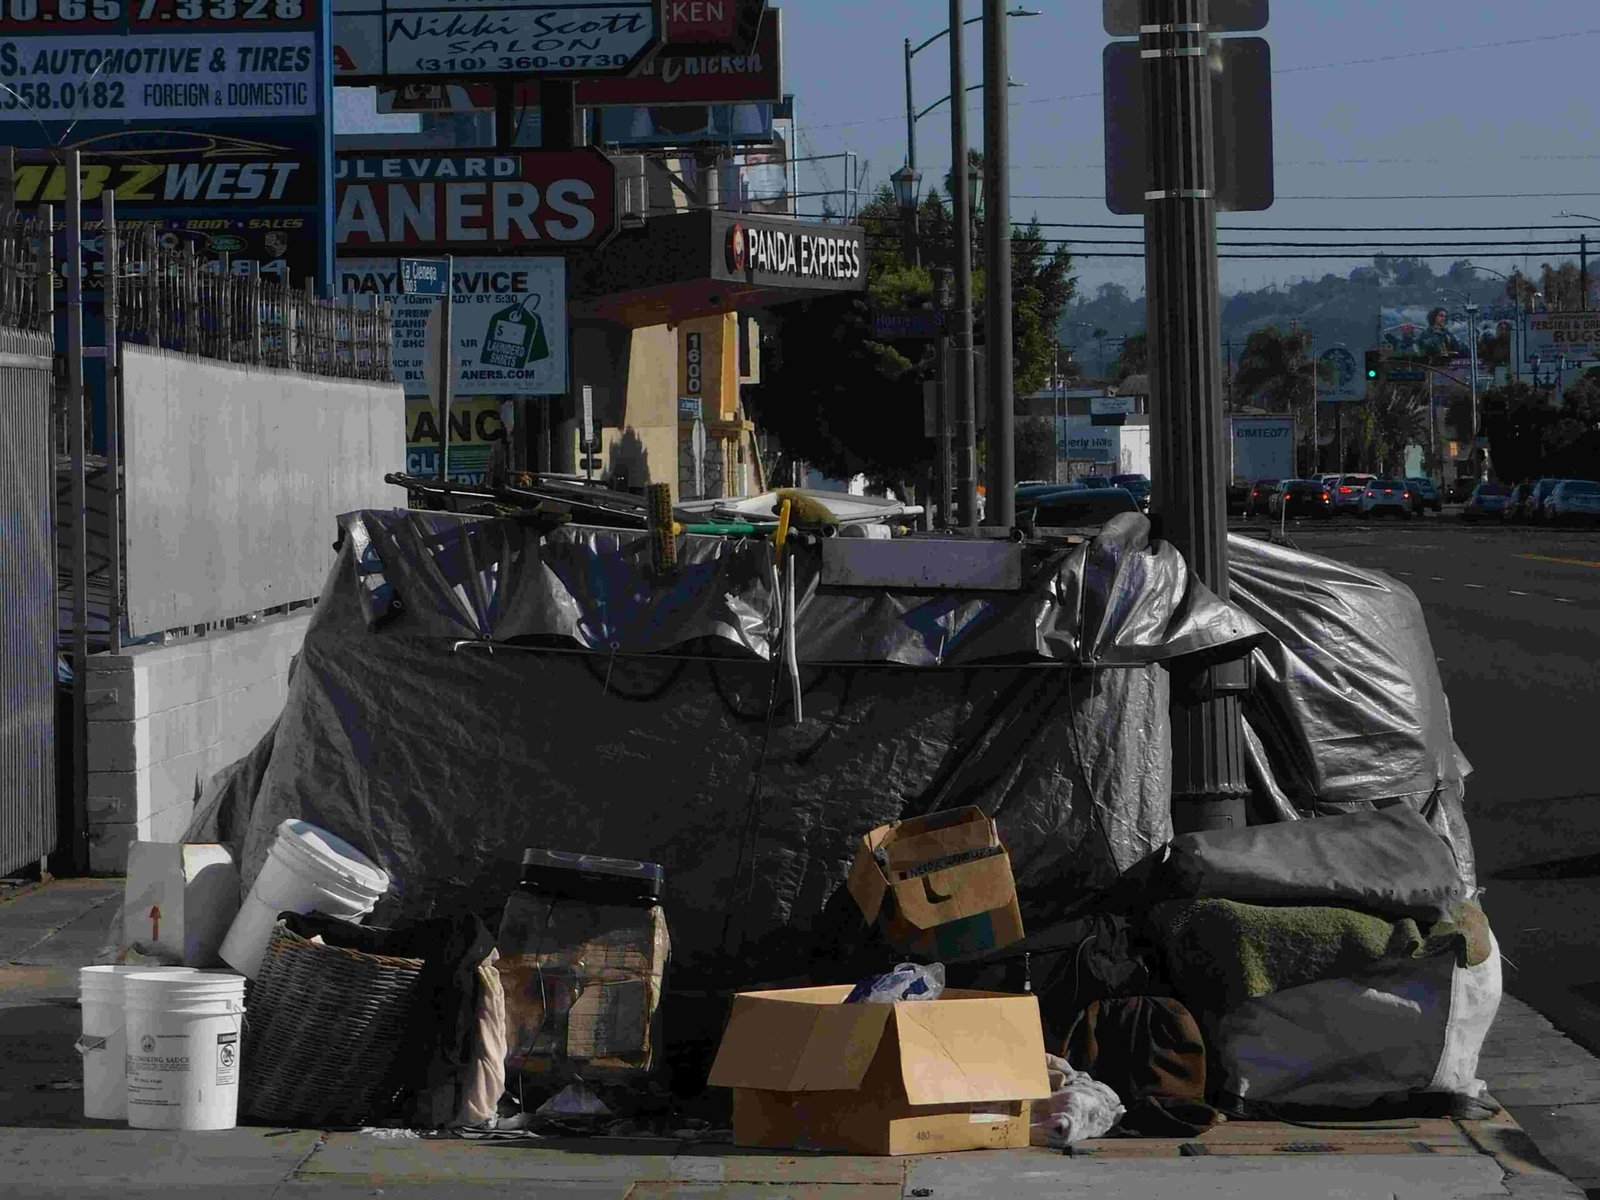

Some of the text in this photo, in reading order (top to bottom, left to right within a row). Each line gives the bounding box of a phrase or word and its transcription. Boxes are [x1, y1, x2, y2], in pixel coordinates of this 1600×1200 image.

[666, 1, 723, 22] KEN
[388, 12, 650, 42] Nikki Scott
[446, 38, 601, 54] SALON
[32, 47, 201, 74] AUTOMOTIVE
[209, 47, 225, 73] &
[237, 45, 310, 73] TIRES
[416, 56, 486, 72] (310)
[497, 53, 629, 70] 360-0730
[0, 82, 125, 109] 358.0182
[144, 82, 307, 107] FOREIGN & DOMESTIC
[186, 219, 235, 229] BODY
[247, 218, 304, 229] SALES
[335, 178, 596, 243] ANERS
[747, 228, 860, 278] PANDA EXPRESS
